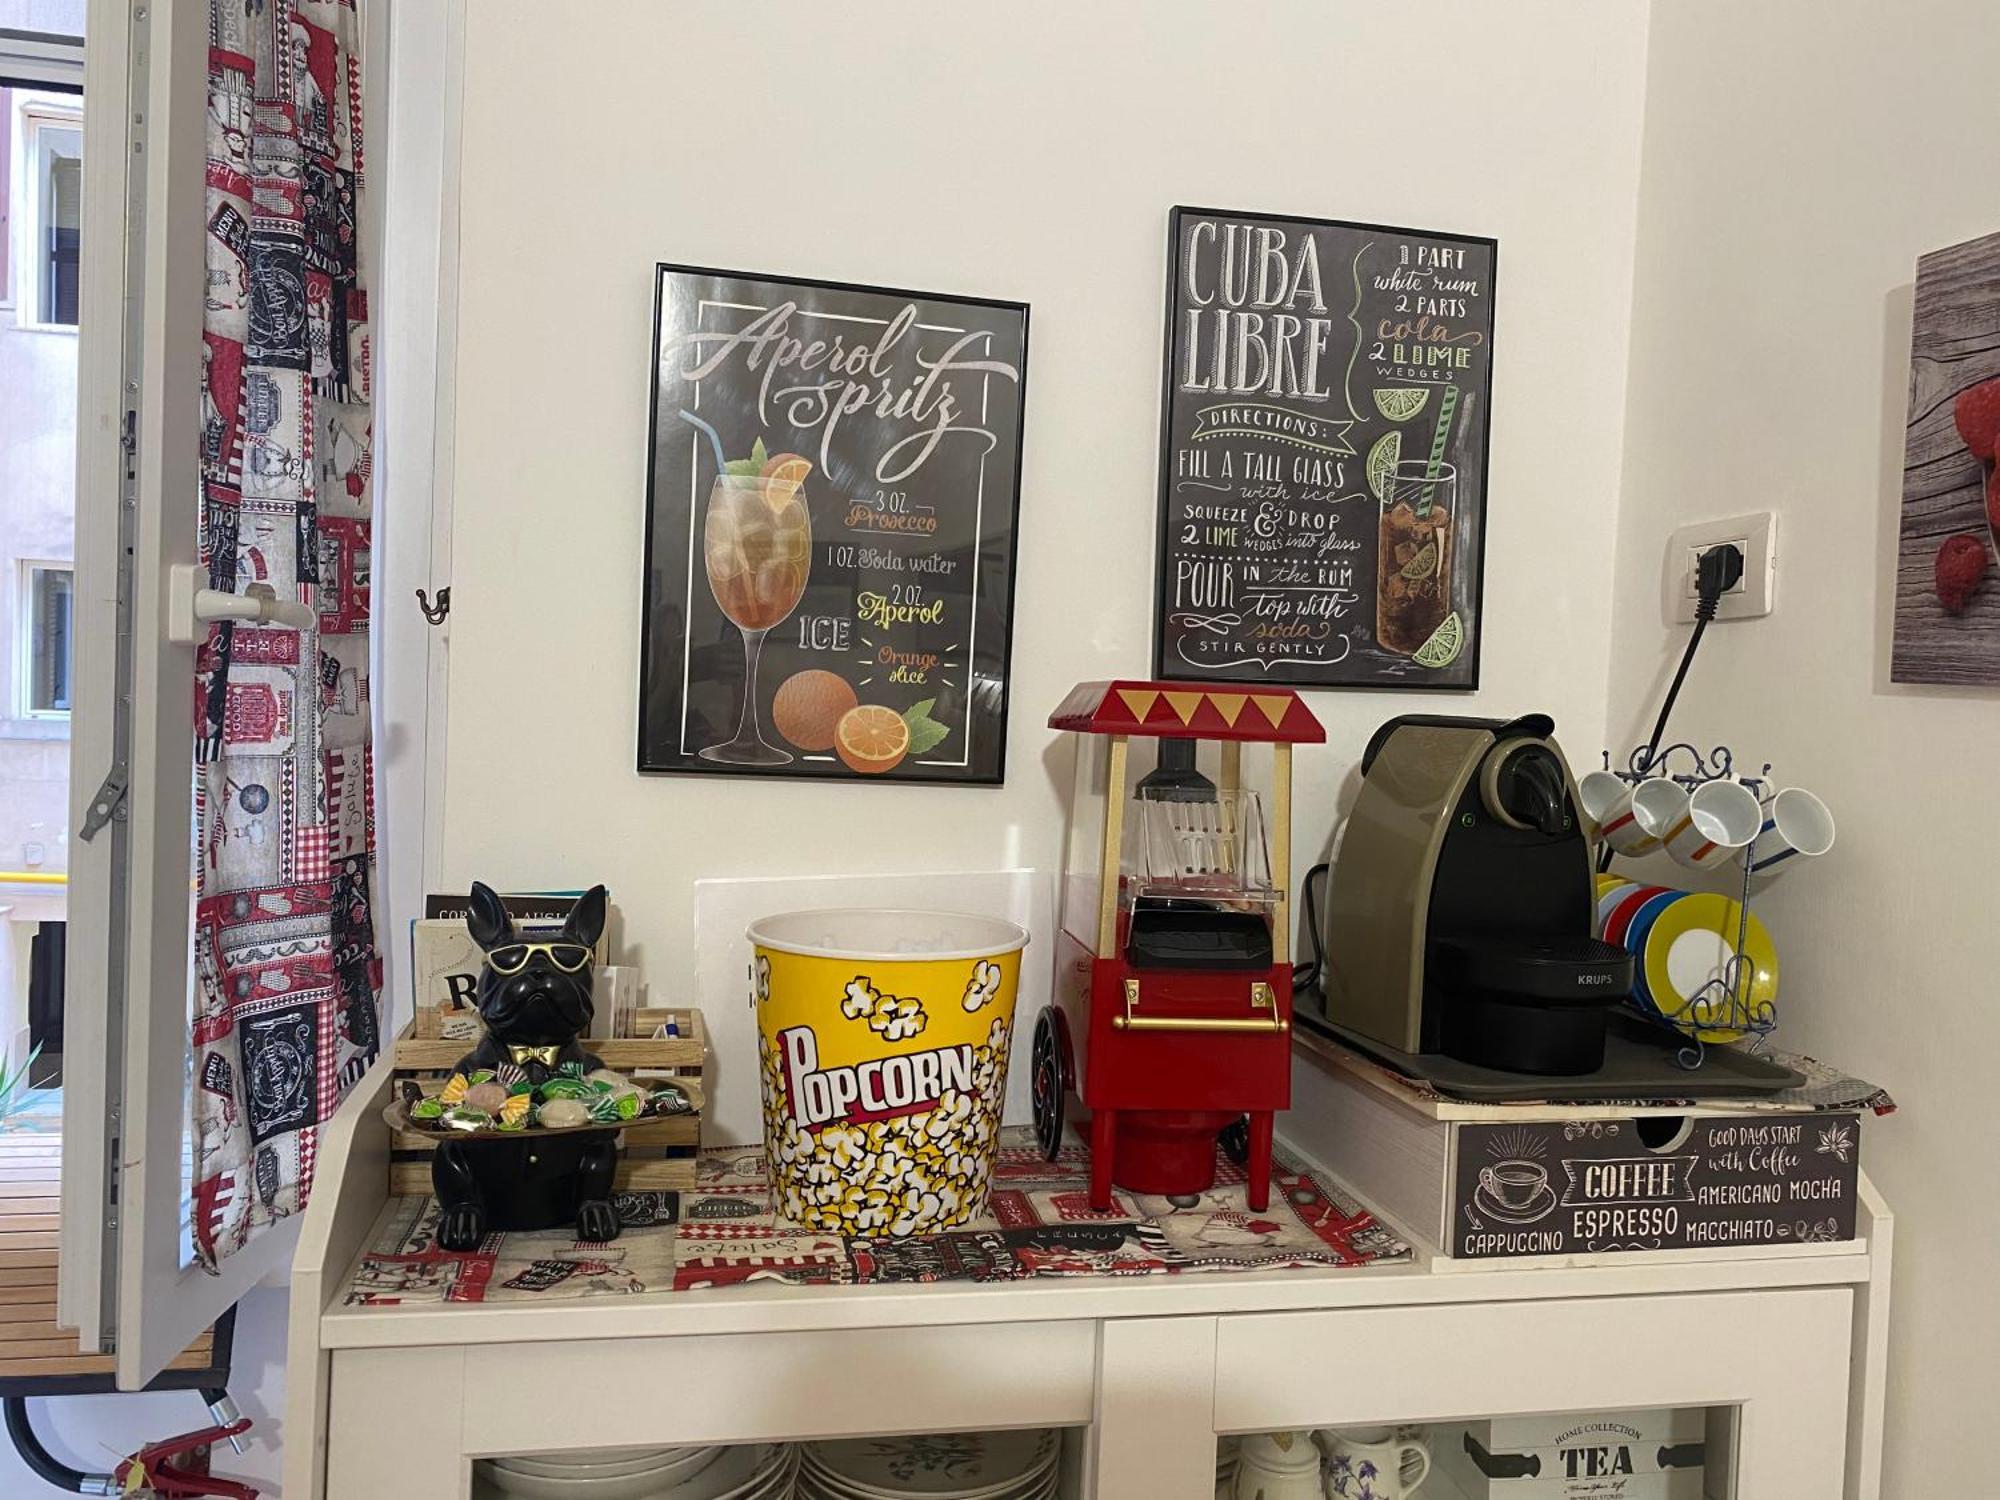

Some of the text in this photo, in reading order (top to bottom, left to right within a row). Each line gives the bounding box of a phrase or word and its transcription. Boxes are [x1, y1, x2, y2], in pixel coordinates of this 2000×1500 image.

[215, 208, 239, 241] MENU
[1184, 221, 1329, 313] CUBA
[1399, 245, 1466, 270] 1 PART
[1373, 269, 1479, 297] white rum
[1394, 295, 1466, 318] 2 PARTS
[1377, 317, 1483, 346] cola
[666, 301, 918, 427] Aperol
[1179, 308, 1333, 402] LIBRE
[1368, 342, 1472, 369] 2 LIME
[1376, 366, 1454, 381] WEDGES
[1211, 411, 1328, 439] DIRECTIONS:
[1179, 450, 1344, 488] FILL A TALL GLASS
[876, 491, 885, 512] 3
[1239, 485, 1290, 501] with
[844, 505, 937, 533] Prosecco
[1183, 502, 1340, 537] SQUEEZE & DROP
[1181, 525, 1361, 557] 2 LIME WEDGES into glass
[827, 547, 832, 566] 1
[858, 549, 902, 572] Soda
[909, 554, 957, 574] water
[892, 584, 901, 606] 2
[1175, 561, 1353, 609] POUR IN the RUM
[857, 591, 944, 629] Aperol
[1296, 594, 1360, 619] with
[798, 614, 850, 651] ICE
[1249, 620, 1331, 640] soda
[878, 646, 940, 670] Orange
[1199, 641, 1326, 656] STIR GENTLY
[889, 666, 928, 685] slice
[1578, 975, 1612, 985] KRUPS
[1708, 1125, 1802, 1148] GOOD DAYS START
[1708, 1146, 1801, 1175] with Coffee
[1585, 1163, 1676, 1199] COFFEE
[1698, 1178, 1842, 1206] AMERICANO MOCHA
[1573, 1207, 1679, 1239] ESPRESSO
[1686, 1219, 1774, 1242] MACCHIATO
[1464, 1231, 1563, 1255] CAPPUCCINO
[1554, 1423, 1643, 1446] HOME COLLECTION
[1559, 1446, 1633, 1478] TEA
